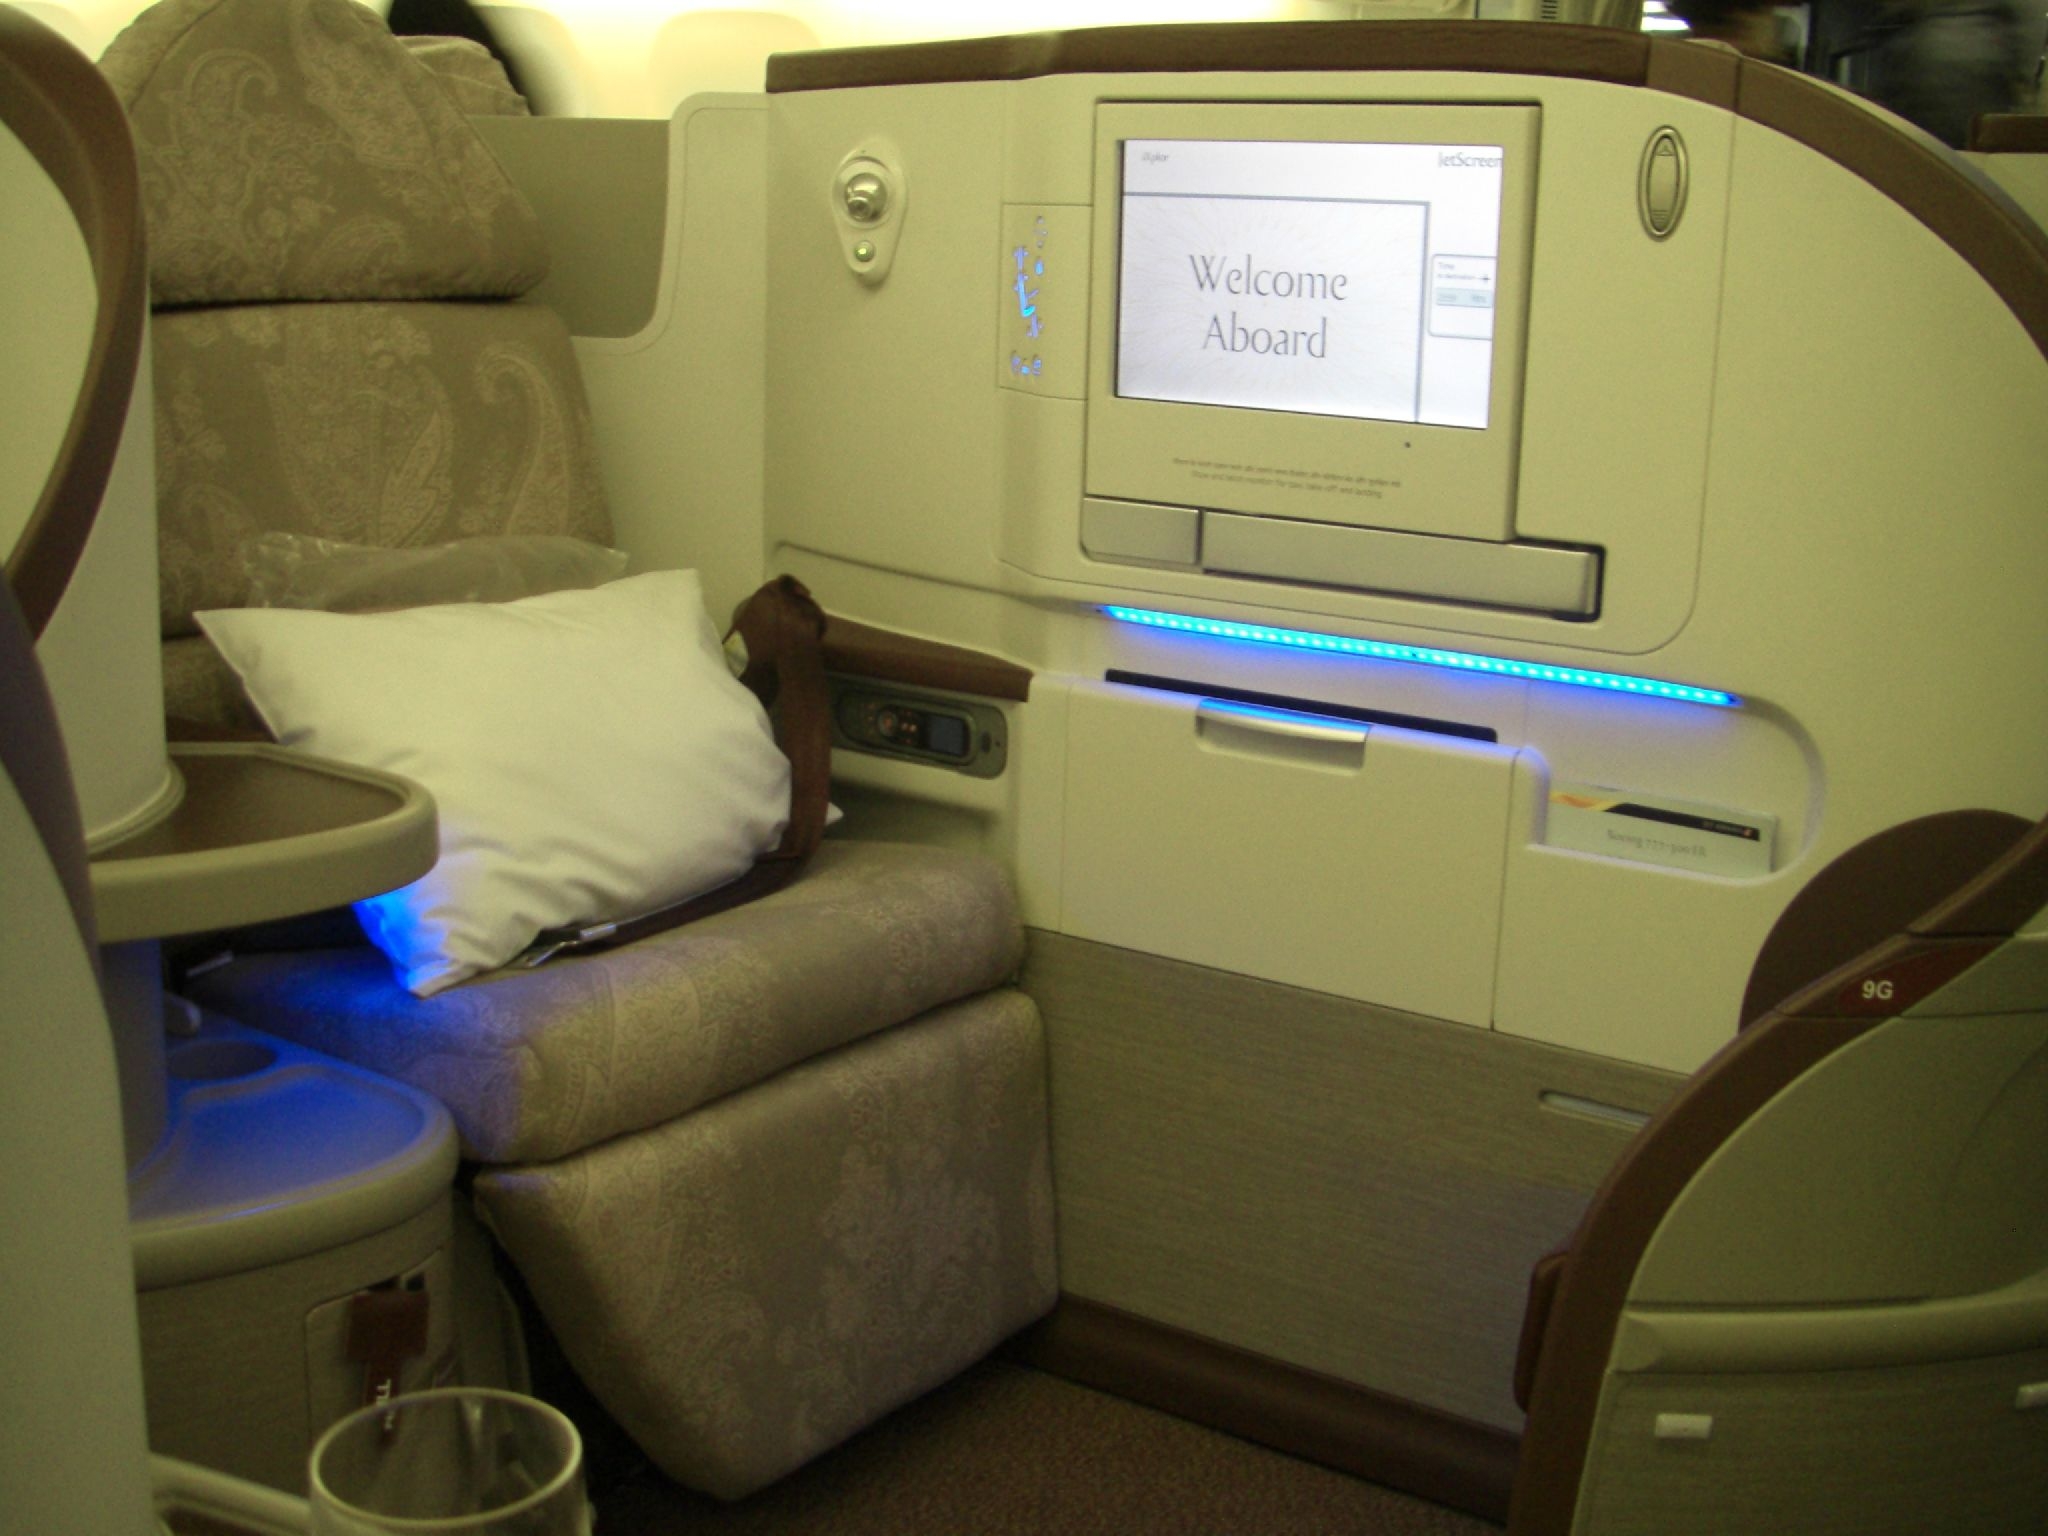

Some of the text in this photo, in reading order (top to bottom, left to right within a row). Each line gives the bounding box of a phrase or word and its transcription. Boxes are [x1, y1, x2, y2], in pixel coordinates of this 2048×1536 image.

[1188, 253, 1348, 301] Welcome
[1202, 311, 1327, 358] Aboard
[1862, 980, 1893, 999] 9G
